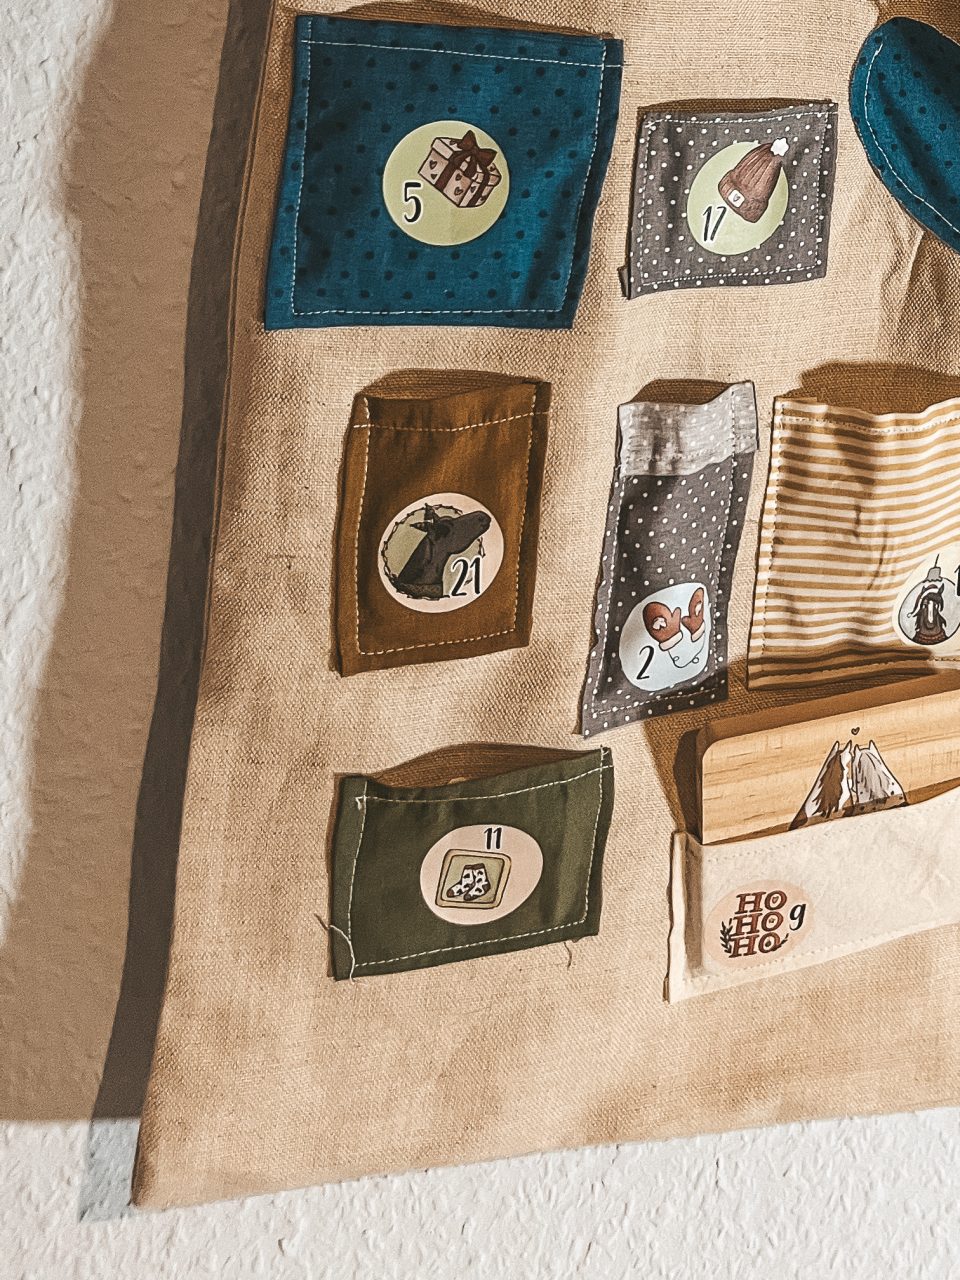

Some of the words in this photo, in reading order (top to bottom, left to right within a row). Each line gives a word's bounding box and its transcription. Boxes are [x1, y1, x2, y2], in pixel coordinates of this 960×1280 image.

[404, 183, 422, 222] 5
[702, 206, 726, 241] 17
[451, 557, 481, 596] 21
[637, 646, 651, 679] 2
[485, 828, 502, 849] 11
[736, 889, 787, 915] HO
[731, 911, 784, 937] HO
[789, 904, 805, 930] 9
[729, 932, 779, 958] HO
